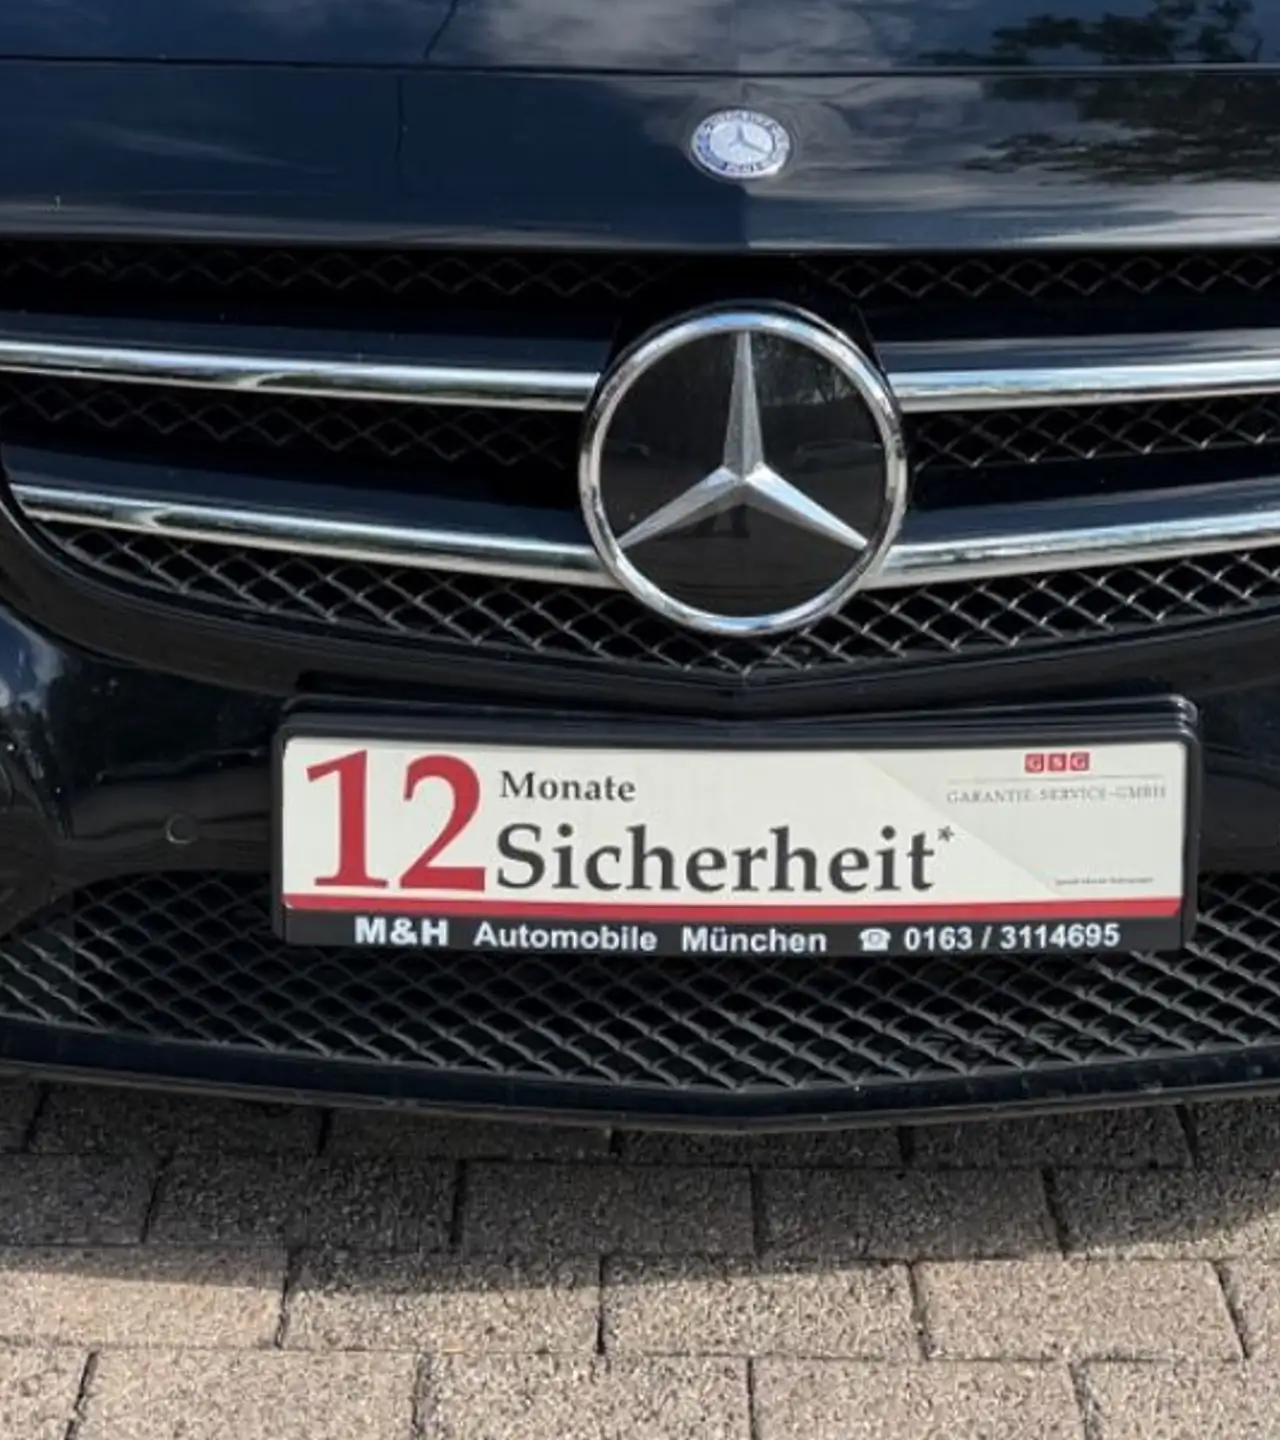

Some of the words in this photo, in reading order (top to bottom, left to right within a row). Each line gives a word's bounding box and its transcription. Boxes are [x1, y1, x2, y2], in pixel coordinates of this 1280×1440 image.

[306, 750, 485, 891] 12
[499, 770, 636, 802] Monate
[354, 917, 448, 946] M&H
[474, 921, 658, 951] Automobile
[681, 926, 827, 953] München
[904, 925, 973, 951] 0163
[981, 926, 992, 950] /
[1001, 923, 1121, 950] 3114695
